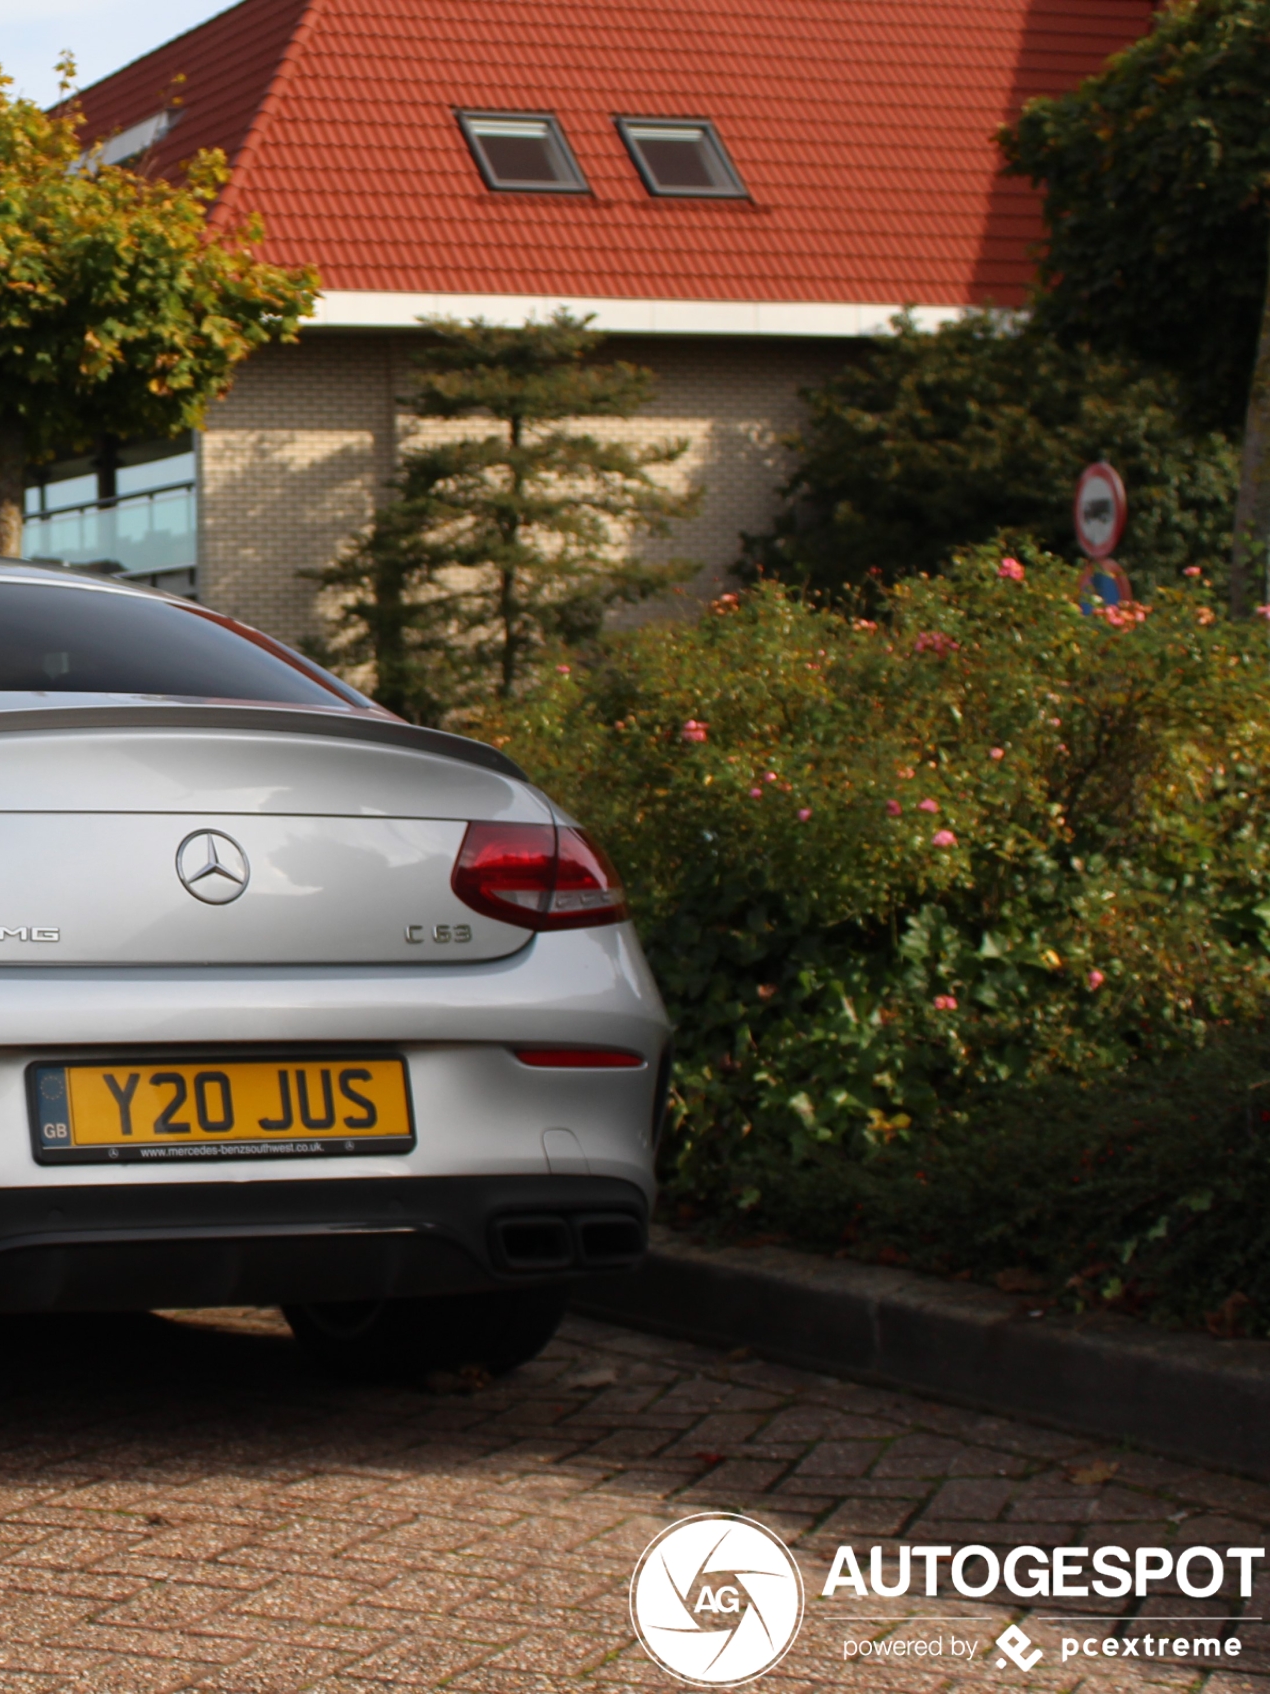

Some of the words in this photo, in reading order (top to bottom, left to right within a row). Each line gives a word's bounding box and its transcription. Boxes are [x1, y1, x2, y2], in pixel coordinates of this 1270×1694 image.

[404, 925, 424, 944] C
[431, 924, 472, 943] 63
[103, 1072, 235, 1136] Y20
[258, 1069, 378, 1132] JUS
[43, 1123, 68, 1139] GB
